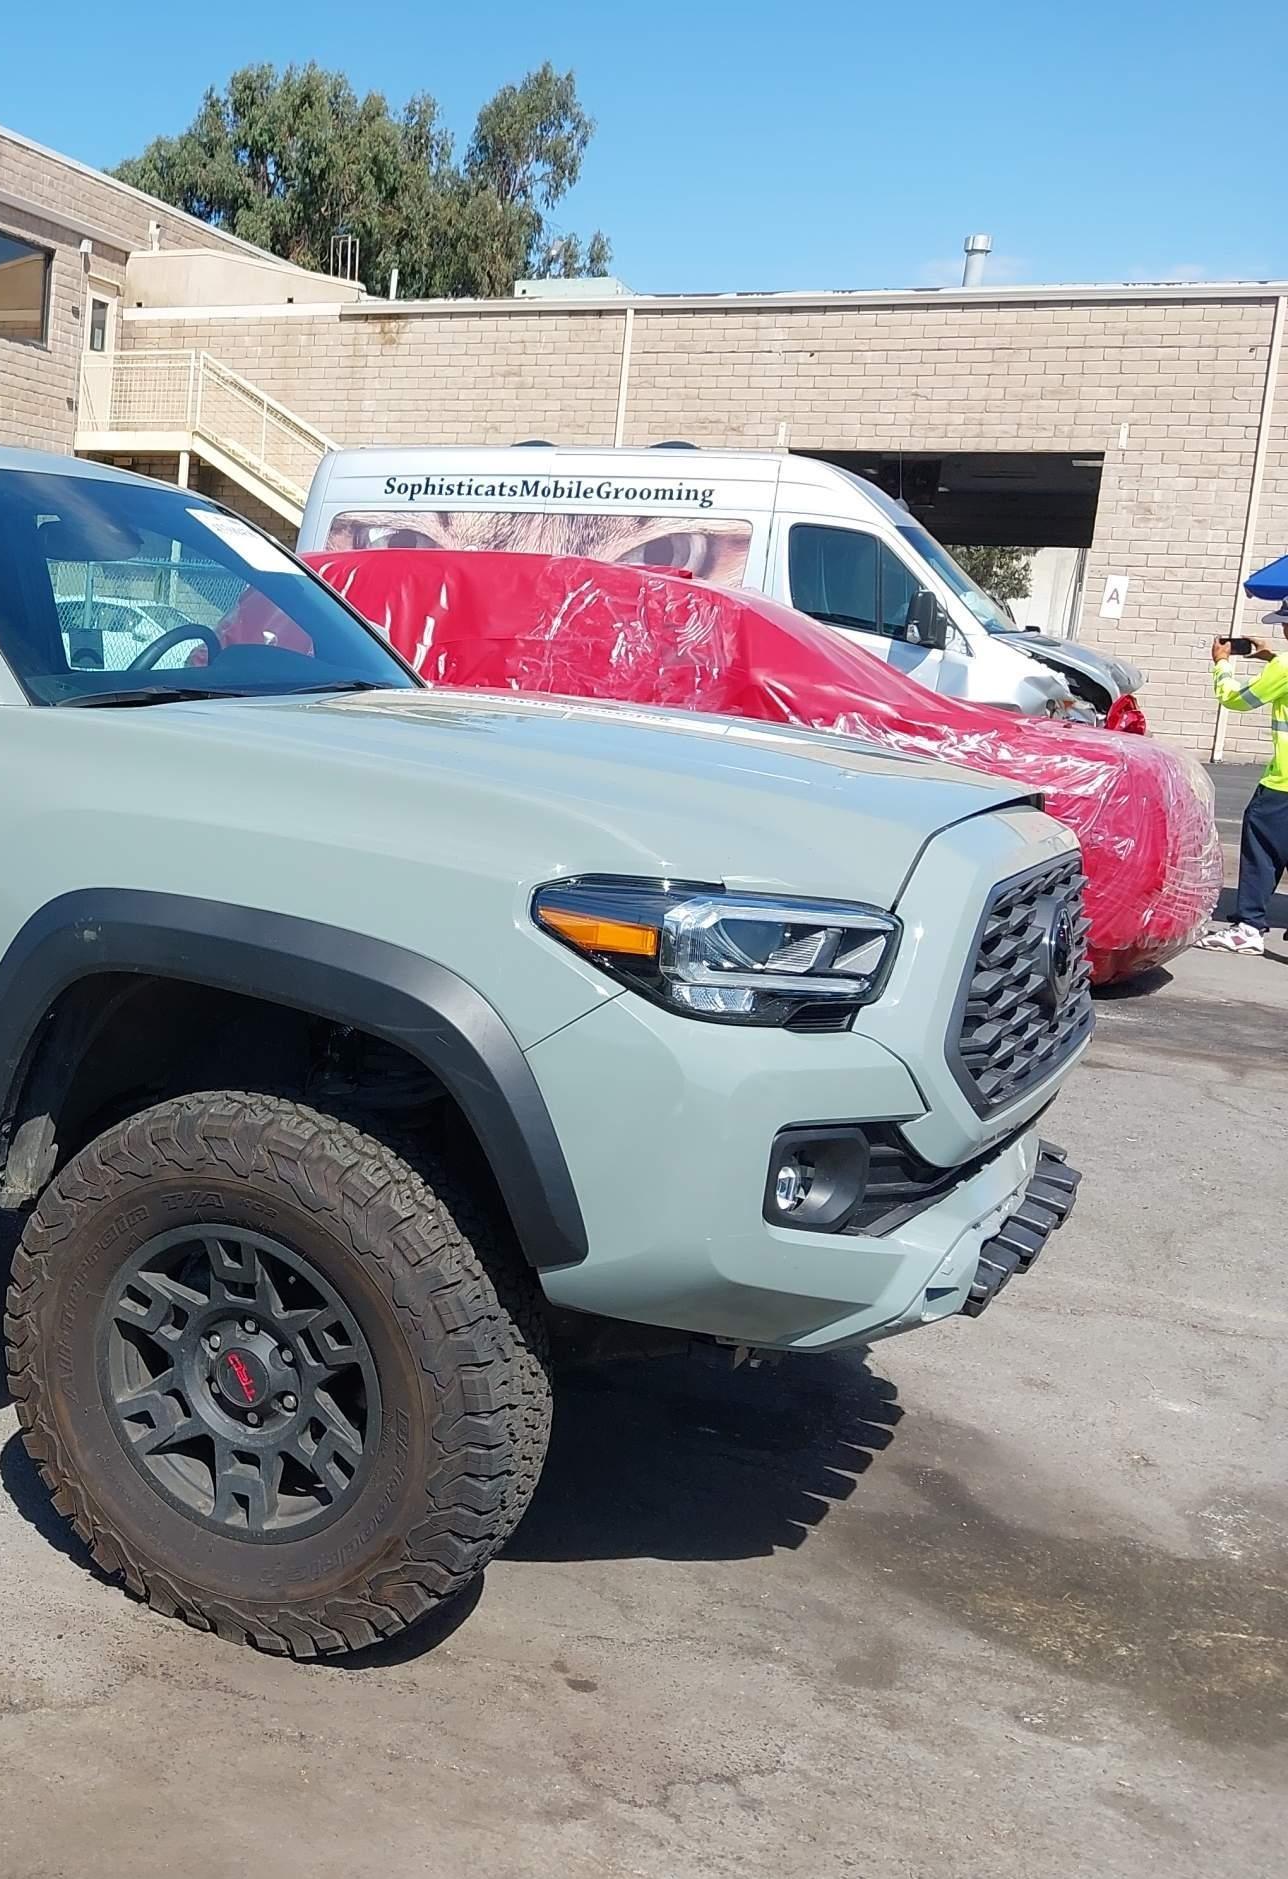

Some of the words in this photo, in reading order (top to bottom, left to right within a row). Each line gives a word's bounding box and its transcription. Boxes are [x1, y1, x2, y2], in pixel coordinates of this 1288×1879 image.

[383, 476, 715, 508] SophisticatsMobileGrooming
[1106, 587, 1121, 605] A
[160, 1190, 226, 1211] T/A
[227, 1353, 256, 1402] TRD
